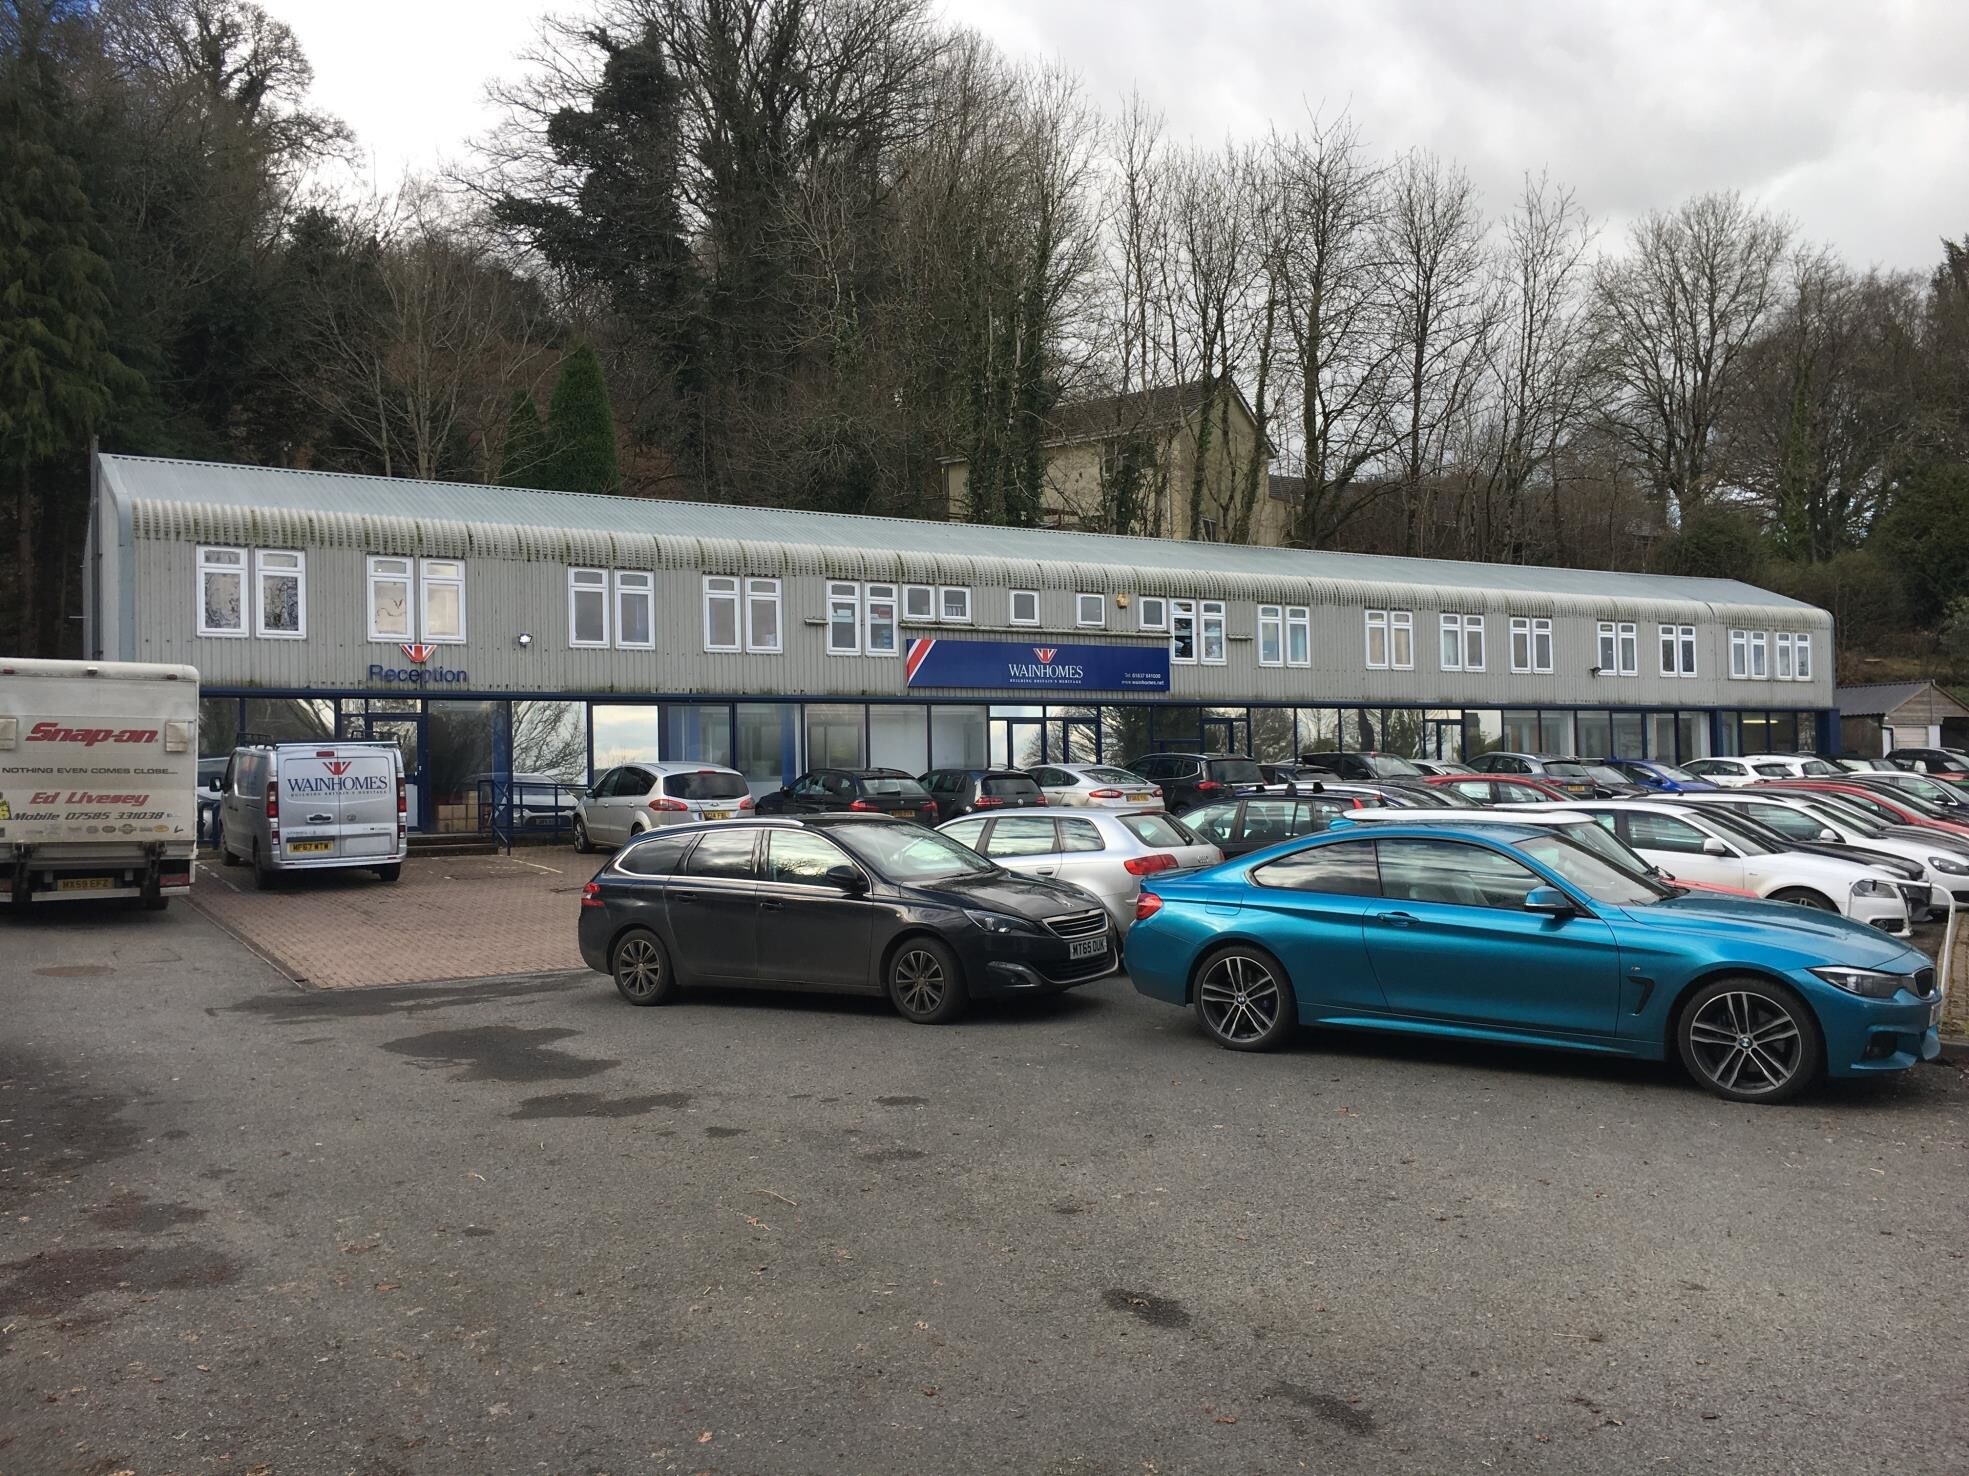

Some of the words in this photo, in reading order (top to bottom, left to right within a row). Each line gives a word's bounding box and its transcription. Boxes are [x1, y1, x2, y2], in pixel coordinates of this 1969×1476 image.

[368, 664, 467, 683] Reception
[1008, 664, 1083, 678] WAINHOMES
[25, 722, 158, 746] Snap-on
[287, 776, 387, 792] WAINHOMES
[29, 792, 60, 804] Ed
[65, 792, 149, 806] Livesey
[14, 812, 60, 821] Mobile
[65, 812, 110, 820] 07585
[115, 811, 165, 820] 331038
[1073, 941, 1091, 956] MT65
